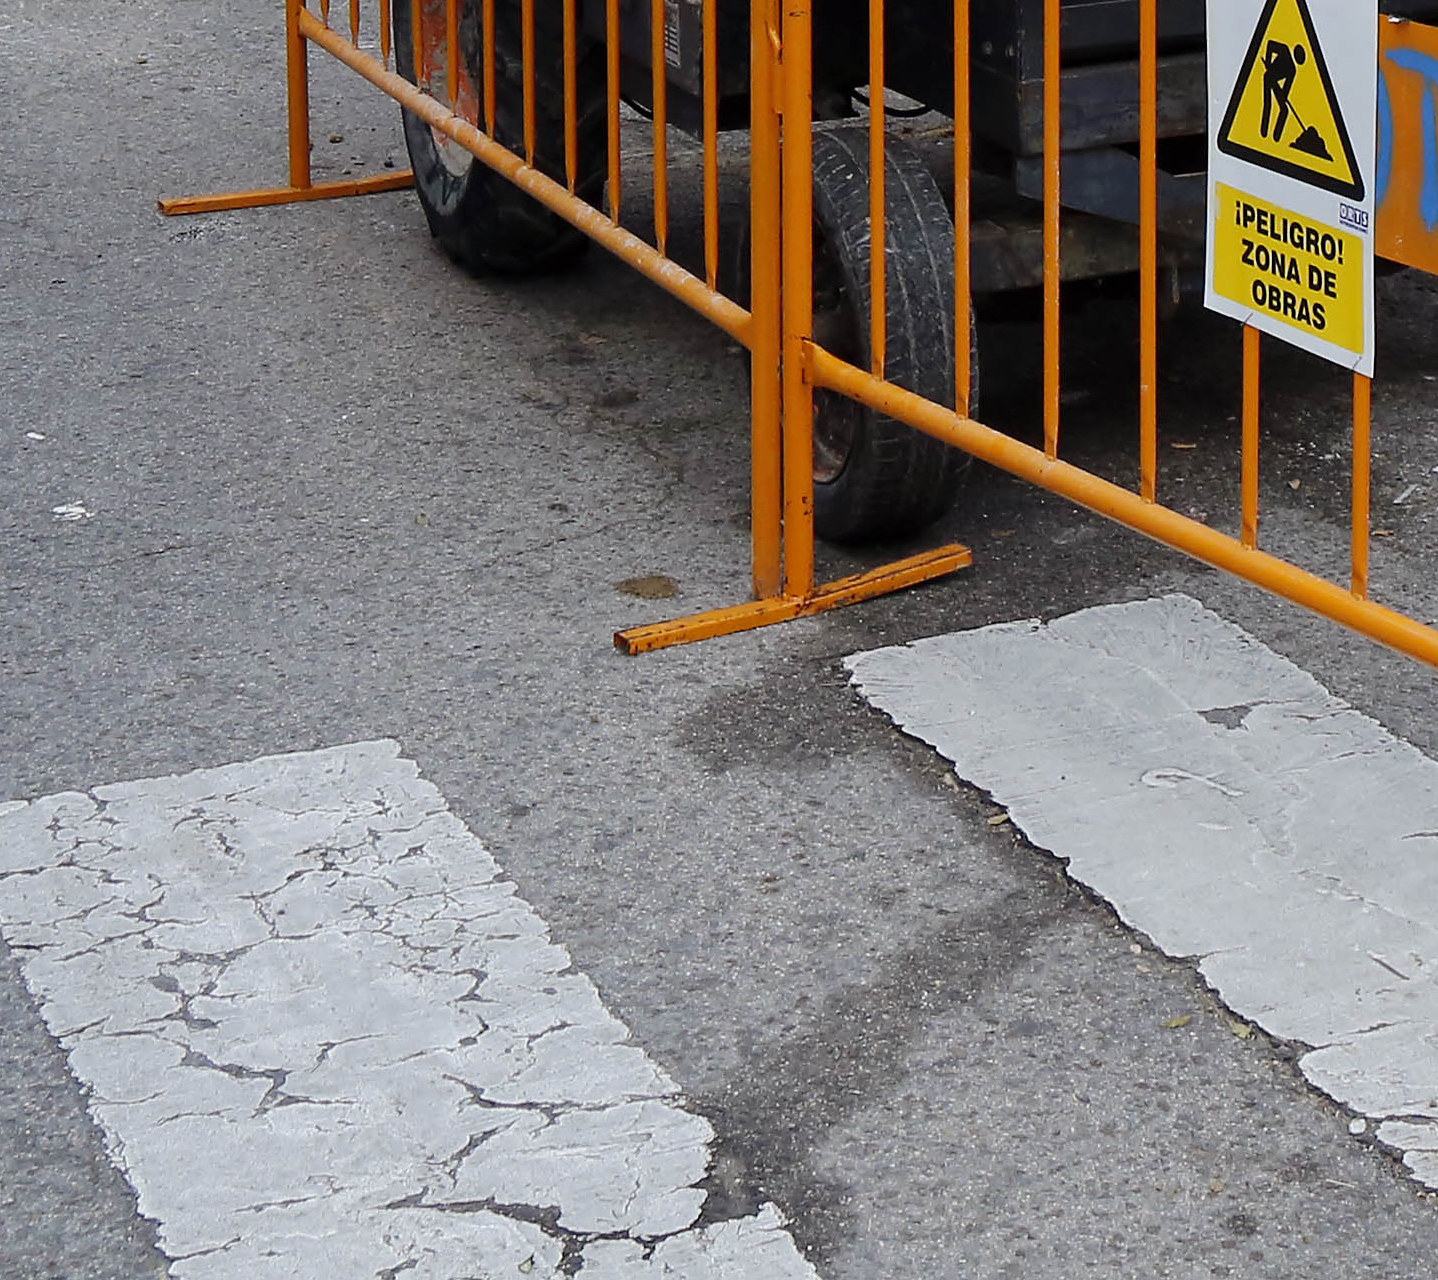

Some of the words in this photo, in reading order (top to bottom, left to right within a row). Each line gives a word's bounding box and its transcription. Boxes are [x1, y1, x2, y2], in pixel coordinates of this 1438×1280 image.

[1235, 200, 1344, 265] ¡PELIGRO!
[1242, 238, 1301, 285] ZONA
[1308, 264, 1338, 299] DE
[1252, 279, 1326, 330] OBRAS
